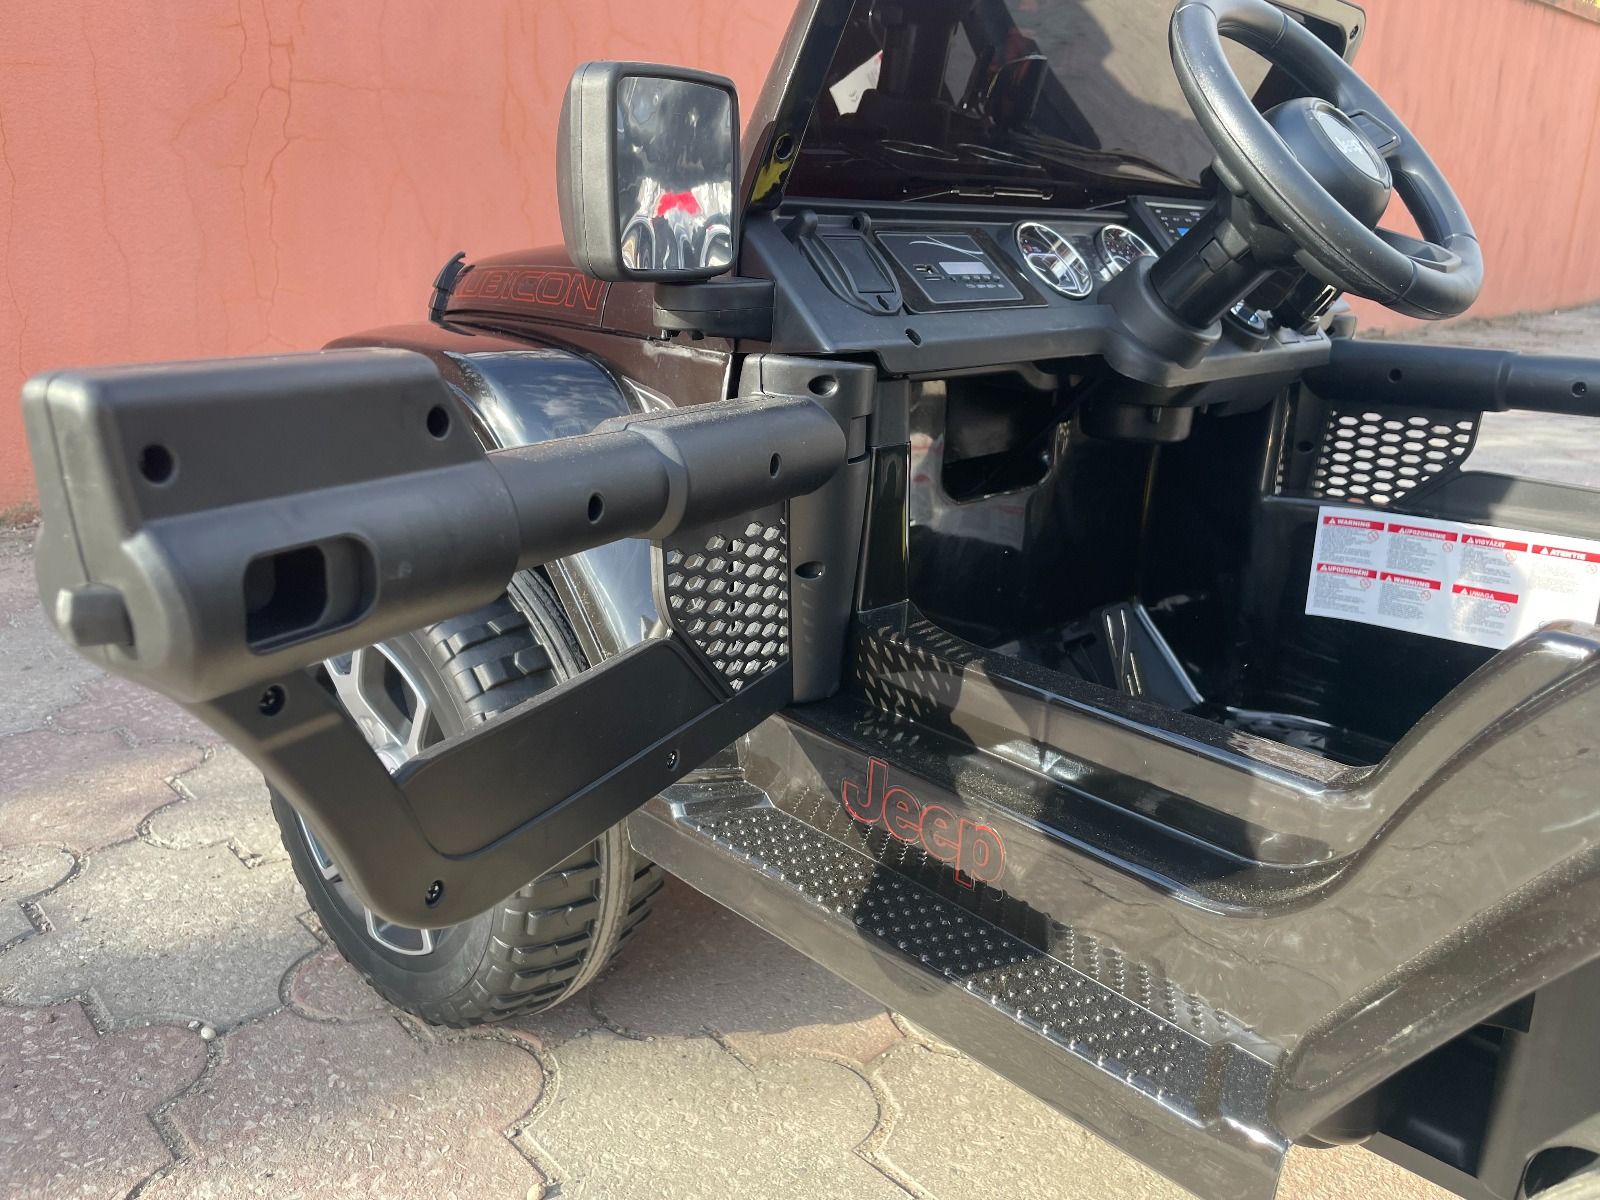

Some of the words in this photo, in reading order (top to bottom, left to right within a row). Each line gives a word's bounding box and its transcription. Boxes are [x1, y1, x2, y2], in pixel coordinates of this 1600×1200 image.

[454, 271, 605, 310] UBICON
[1336, 518, 1371, 529] WARNING
[1392, 576, 1431, 589] WARNUNG
[1468, 589, 1495, 600] UWAGA
[841, 756, 1007, 890] Jeep
